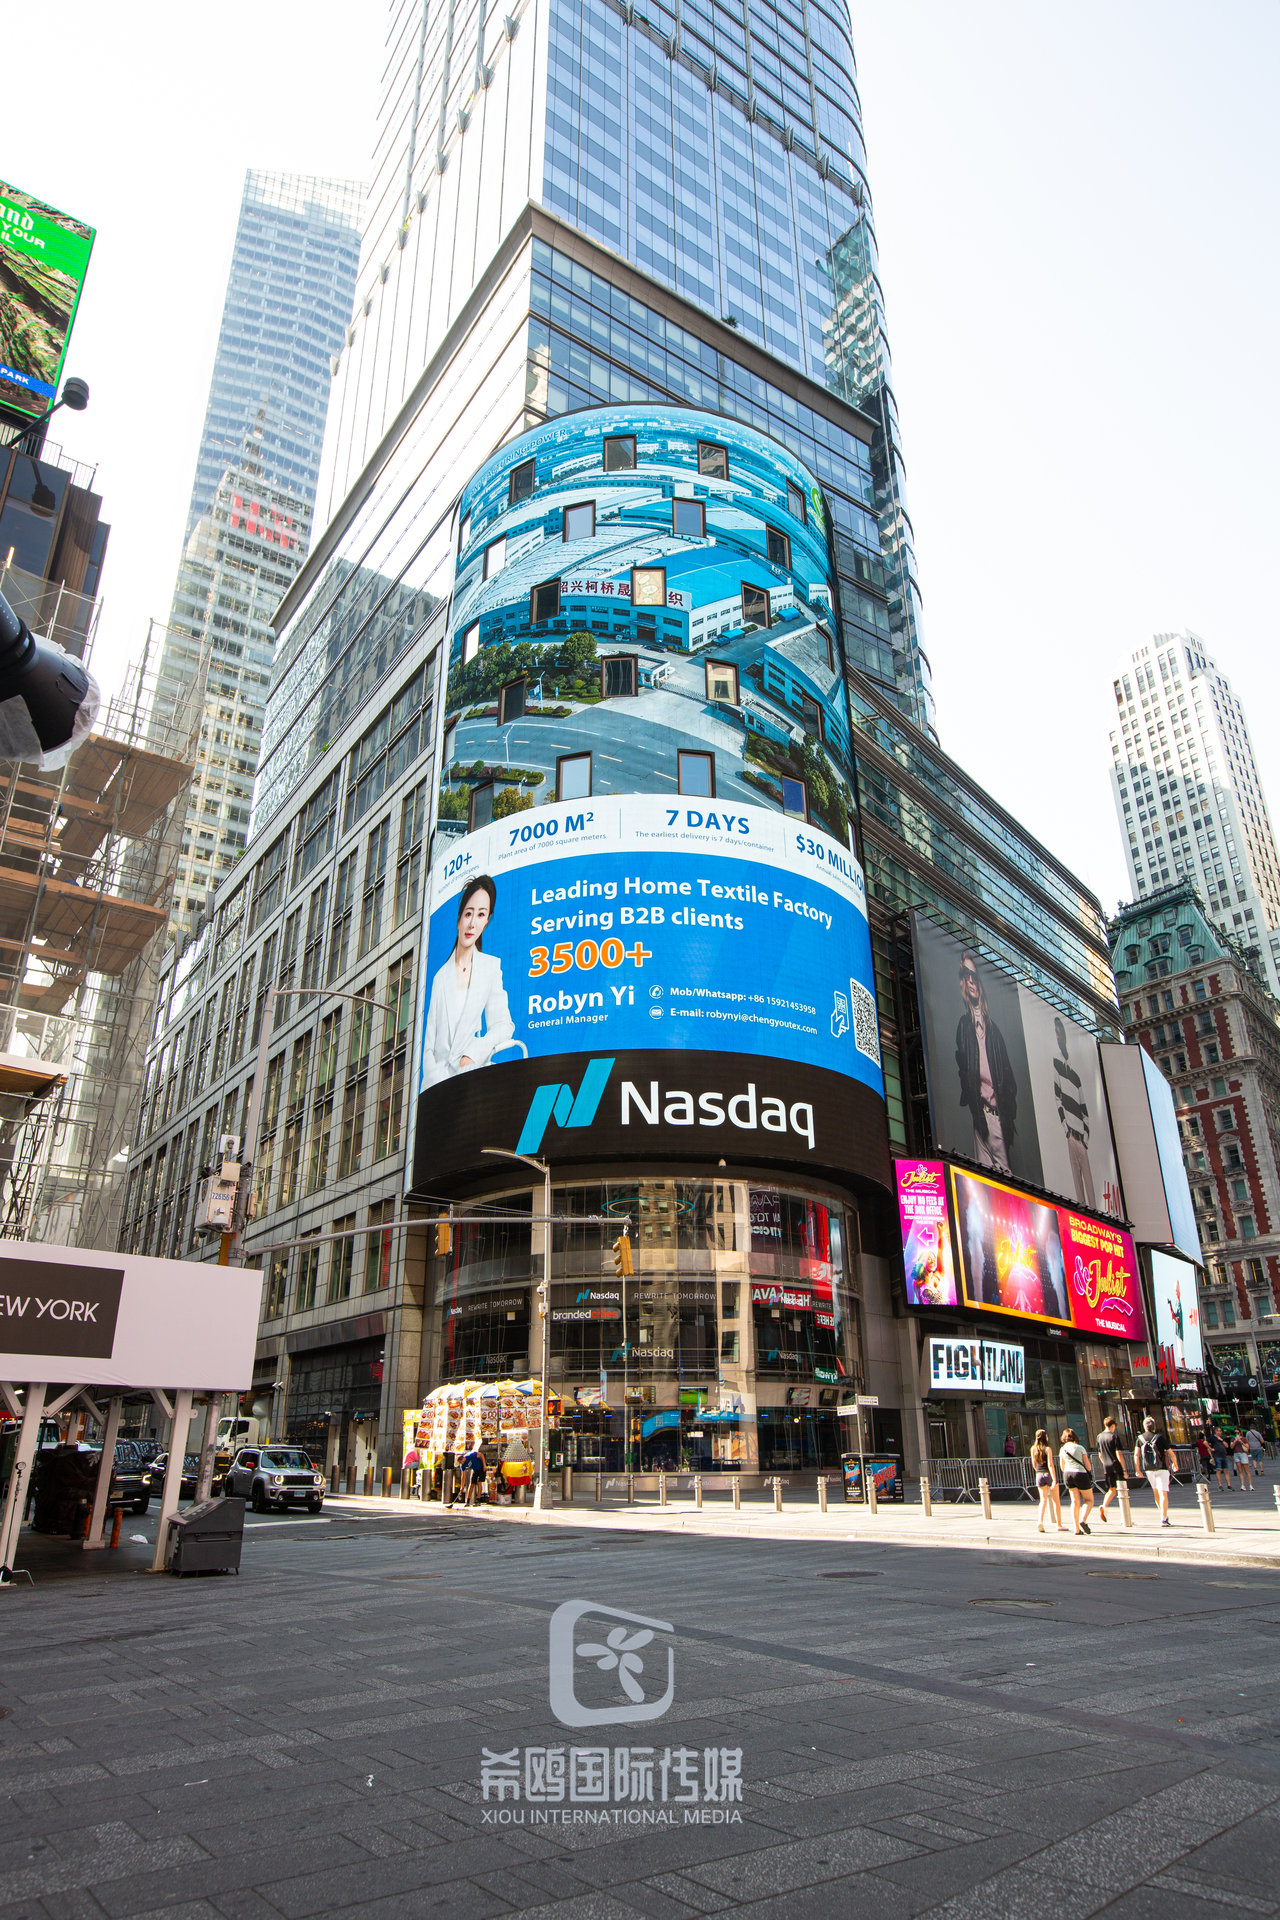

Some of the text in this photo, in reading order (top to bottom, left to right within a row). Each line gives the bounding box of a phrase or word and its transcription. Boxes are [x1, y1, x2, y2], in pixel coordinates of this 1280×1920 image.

[2, 220, 45, 249] YOUR
[1, 367, 29, 385] PARK
[527, 428, 567, 448] POWER
[509, 819, 559, 847] 7000
[666, 809, 750, 835] 7 DAYS
[498, 832, 606, 861] Plant area of 7000 square meters
[650, 831, 679, 839] earliest
[680, 832, 710, 842] delivery
[725, 837, 774, 853] days/container
[796, 833, 825, 860] $30
[443, 852, 473, 880] 120+
[531, 876, 832, 930] Leading Home Textile Factory
[530, 906, 744, 935] Serving B2B clients
[528, 937, 652, 978] 3500+
[528, 985, 635, 1015] Robyn Yi
[670, 987, 817, 1015] Mob/Whatsapp: +86 15921453958
[528, 1014, 609, 1029] General Manager
[670, 1008, 818, 1035] E-mail: robynyi@chengyoutex.com
[621, 1080, 816, 1150] Nasdaq
[900, 1170, 941, 1187] Juliet
[1069, 1216, 1123, 1244] BROADWAY'S
[1070, 1228, 1124, 1259] BIGGEST POP HIT
[590, 1291, 717, 1301] Nasdaq REWRITE TOMORROW
[1086, 1259, 1131, 1309] Juliet
[35, 1297, 100, 1322] YORK
[467, 1303, 488, 1312] REWRITE
[490, 1299, 523, 1308] TOMORROW
[553, 1309, 618, 1320] brandedcities
[812, 1301, 832, 1310] REWRITE
[1095, 1318, 1127, 1332] THE MUSICAL
[632, 1347, 674, 1359] Nasdaq
[932, 1344, 1024, 1384] FIGHTLAND
